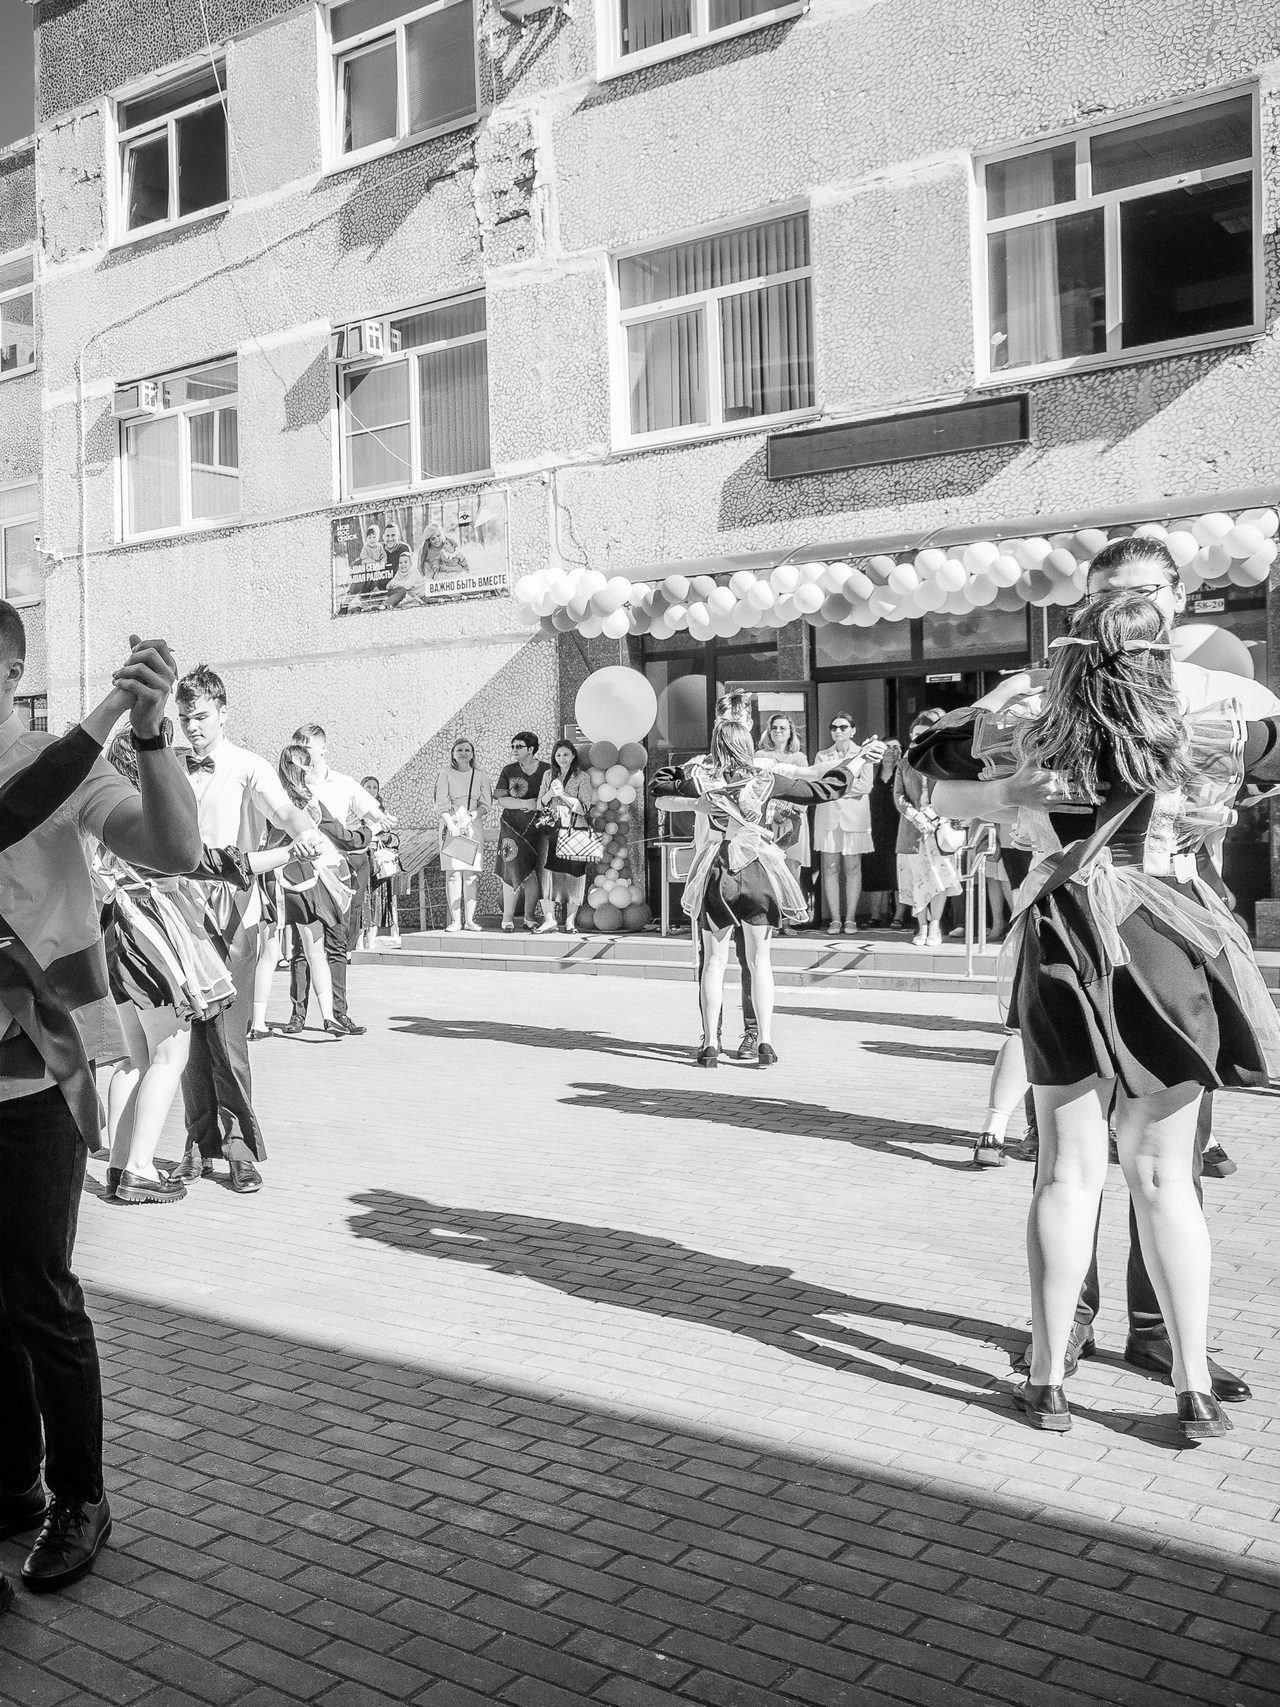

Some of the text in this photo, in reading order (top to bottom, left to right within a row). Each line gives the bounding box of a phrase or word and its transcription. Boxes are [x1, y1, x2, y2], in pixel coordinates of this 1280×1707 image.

[429, 573, 507, 594] ВАЖНО БЫТЬ ВМЕСТЕ
